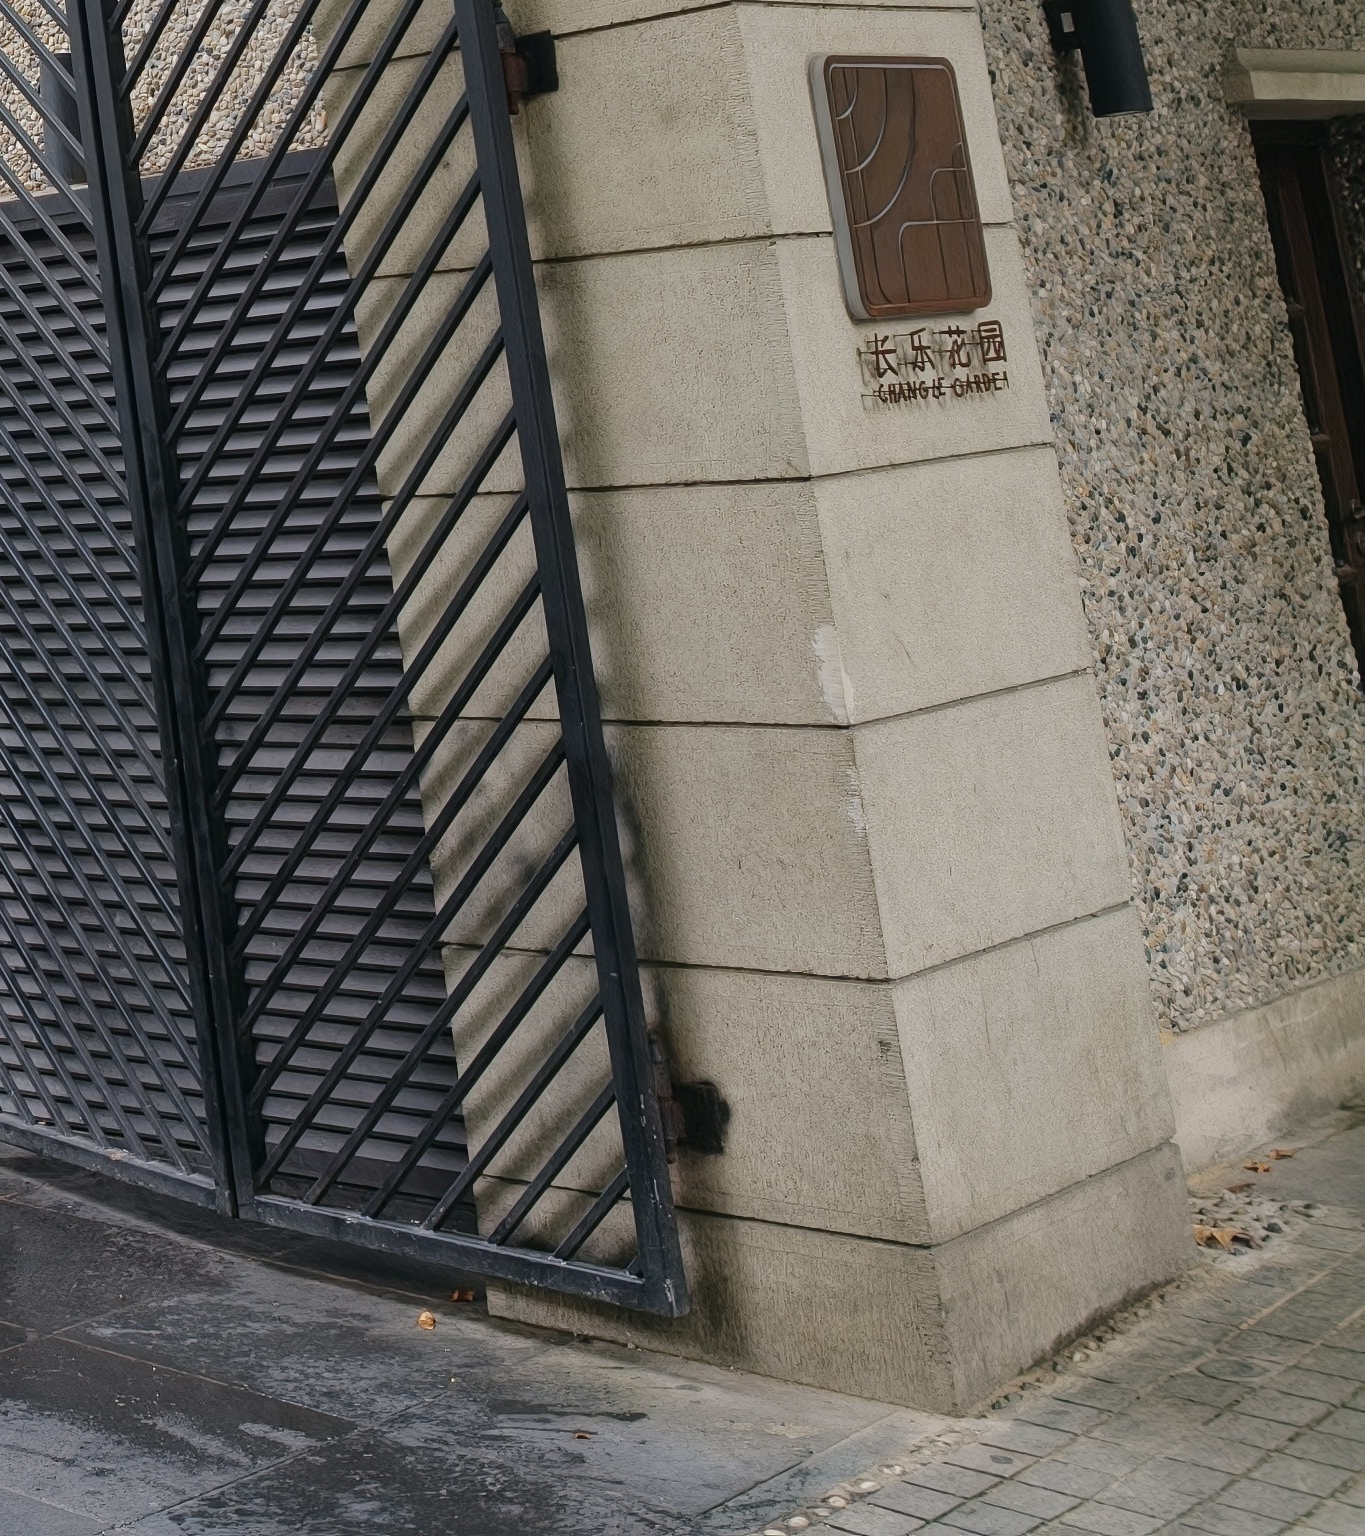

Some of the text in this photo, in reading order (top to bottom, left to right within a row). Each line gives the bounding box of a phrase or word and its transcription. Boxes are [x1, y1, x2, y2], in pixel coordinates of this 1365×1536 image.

[870, 319, 1008, 378] 长乐花园
[878, 377, 946, 403] CHANGLE
